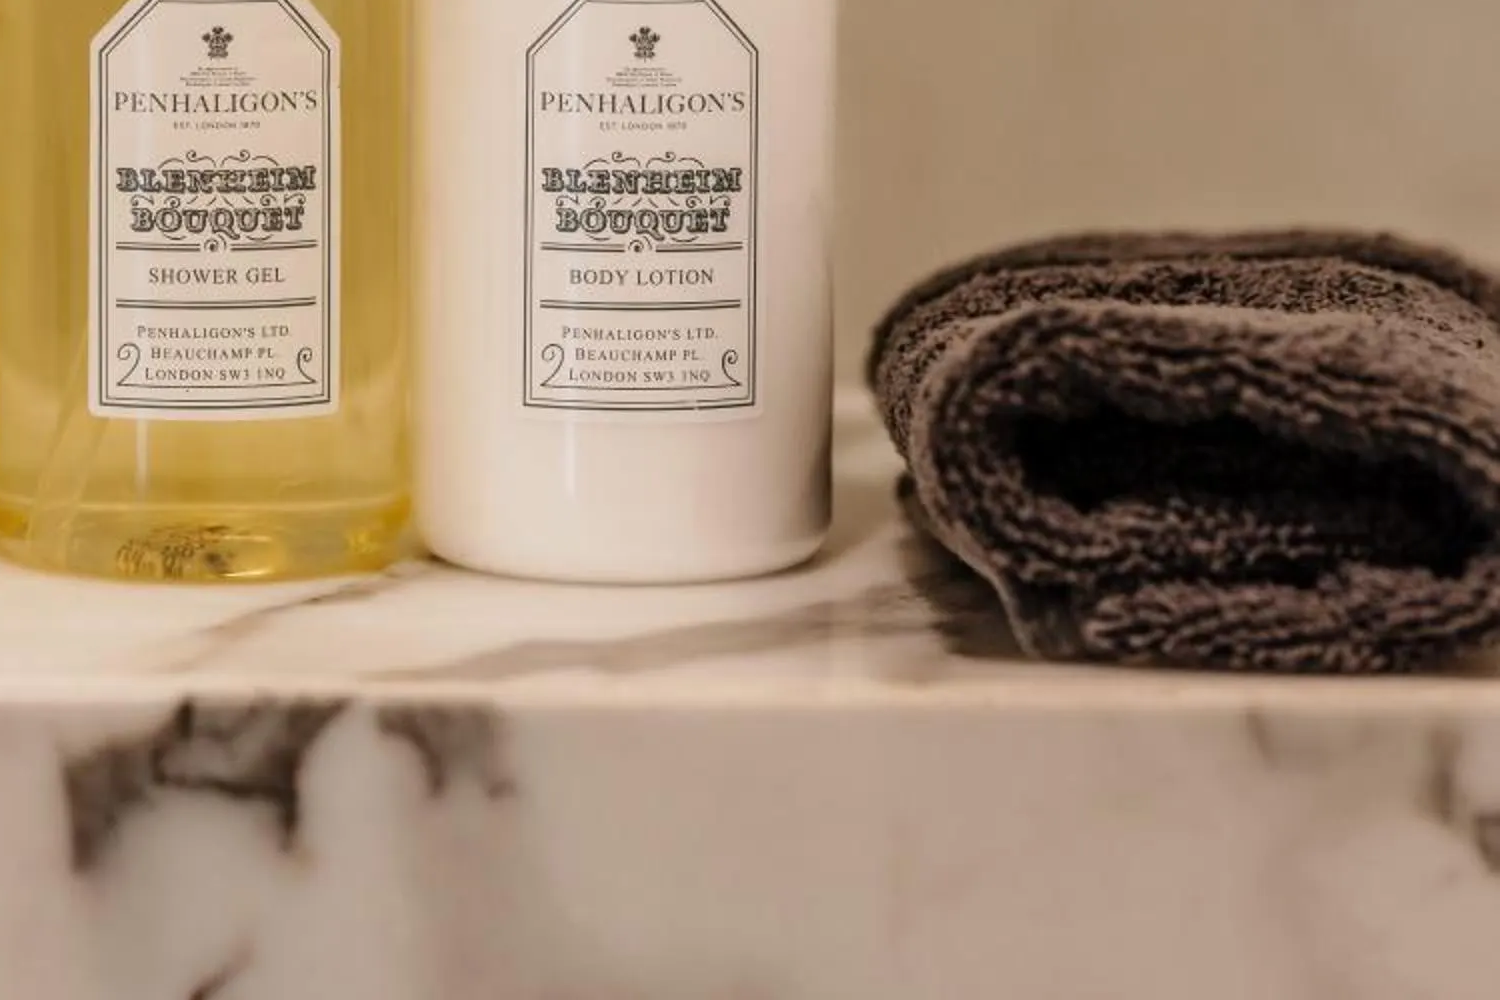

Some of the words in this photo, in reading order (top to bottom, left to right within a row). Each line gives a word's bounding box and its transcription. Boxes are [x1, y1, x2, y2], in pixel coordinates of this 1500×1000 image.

[115, 90, 317, 113] PENHALIGON'S
[541, 92, 745, 114] PENHALIGON'S
[116, 166, 317, 193] BLENHEIM
[542, 168, 742, 195] BLENHEIM
[131, 206, 306, 239] BOUQUET
[555, 207, 730, 241] BOUQUET
[149, 267, 237, 285] SHOWER
[246, 267, 286, 284] GEL
[570, 269, 628, 286] BODY
[637, 268, 714, 286] LOTION
[137, 326, 255, 339] PENHALIGON'S
[562, 325, 680, 340] PENHALIGON'S
[151, 347, 253, 360] BEAUCHAMP
[576, 348, 677, 361] BEAUCHAMP
[145, 368, 213, 381] LONDON
[569, 368, 637, 382] LONDON
